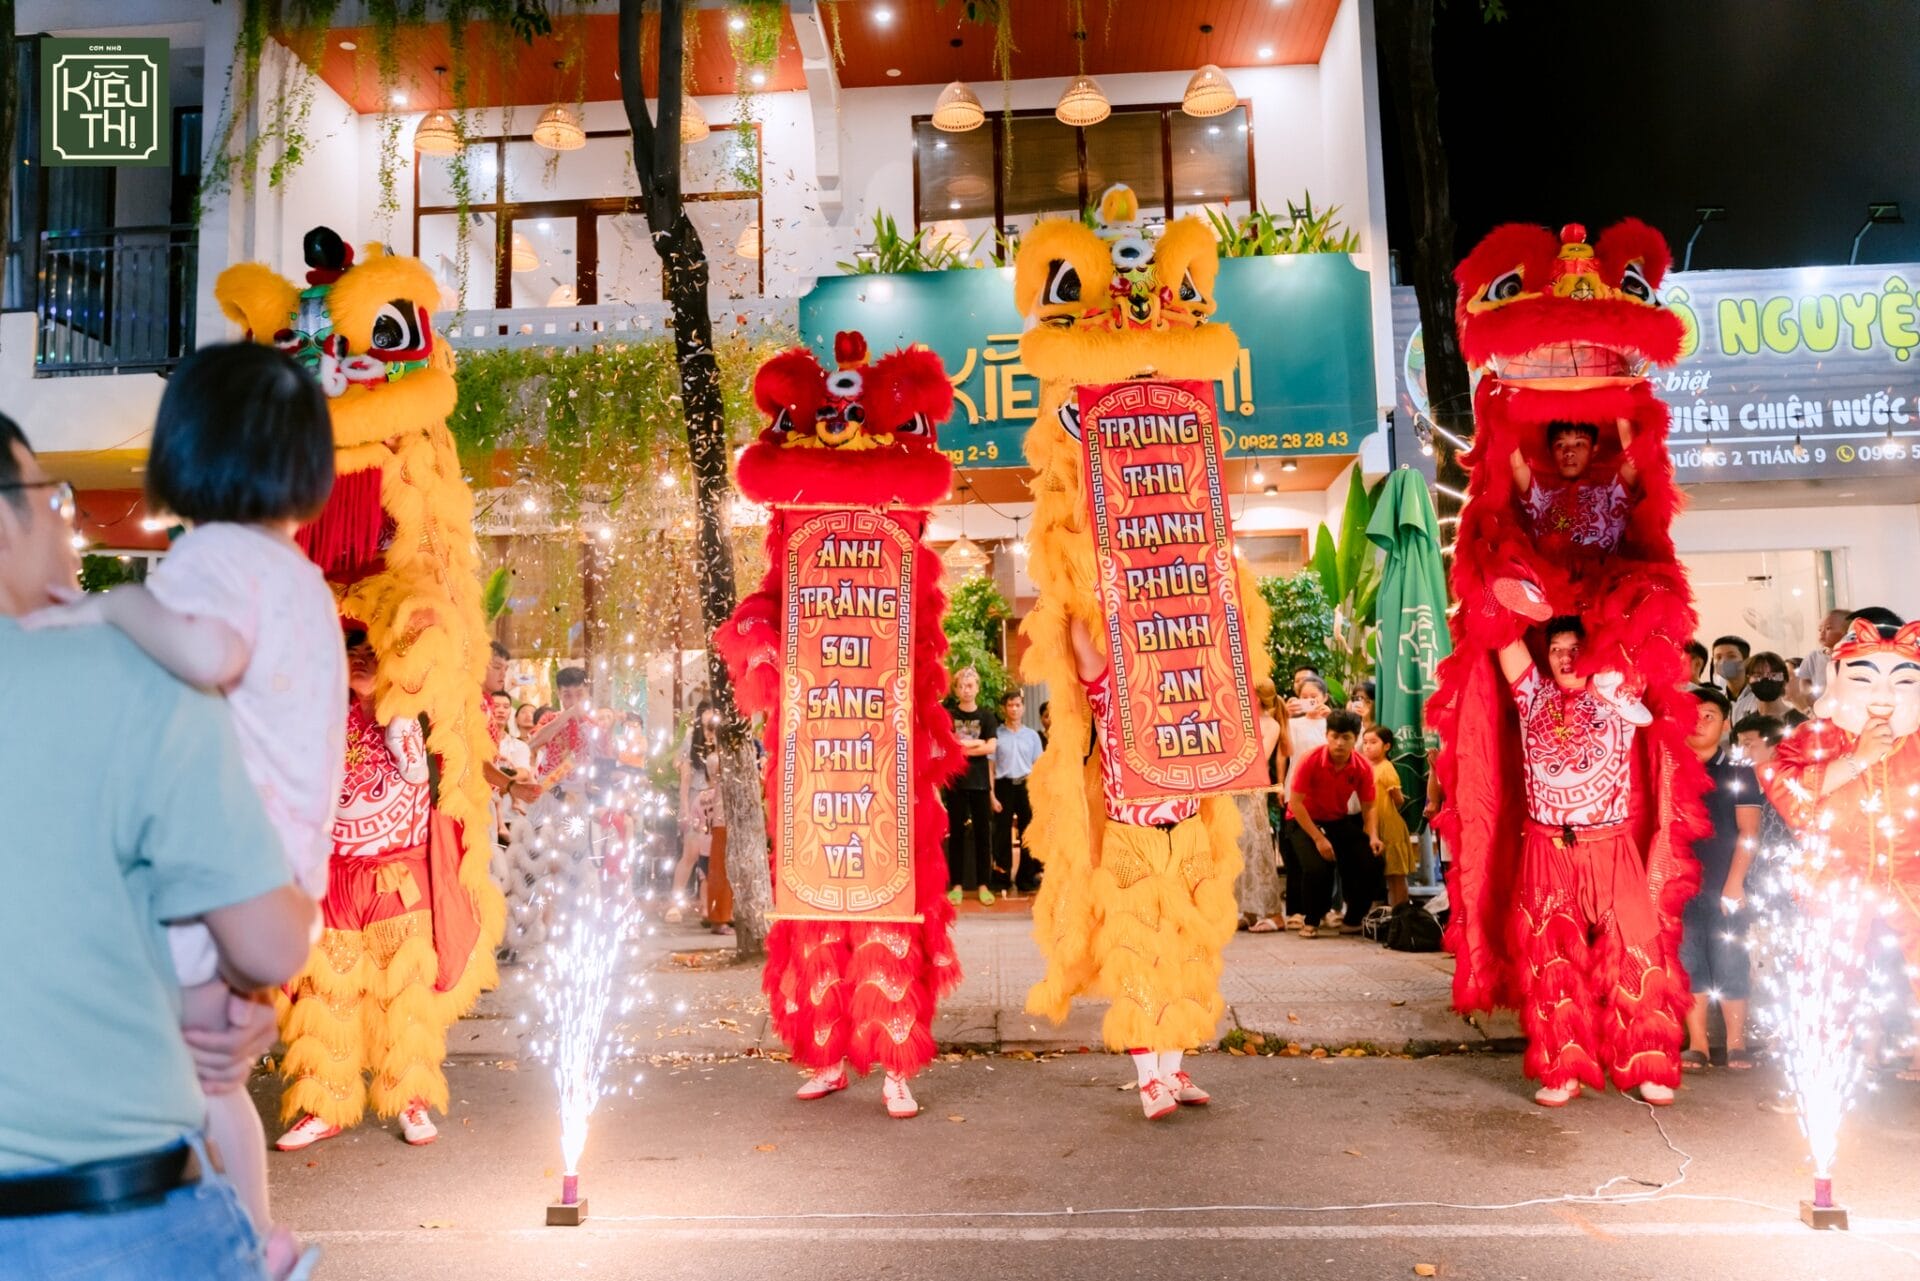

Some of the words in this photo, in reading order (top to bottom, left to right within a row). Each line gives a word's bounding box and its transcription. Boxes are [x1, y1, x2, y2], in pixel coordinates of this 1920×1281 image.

[1718, 276, 1920, 362] NGUYỆ
[1665, 370, 1712, 396] biệt
[1099, 412, 1201, 449] TRUNG
[1739, 394, 1823, 431] CHIÊN
[1832, 391, 1910, 428] NƯỚC
[1239, 434, 1278, 450] 0982
[1282, 433, 1302, 449] 28
[1304, 432, 1325, 448] 28
[1327, 431, 1349, 446] 43
[1669, 446, 1727, 468] ƯỜG
[1731, 450, 1743, 466] 2
[1747, 445, 1810, 466] THÁNG
[1815, 447, 1827, 463] 9
[1122, 463, 1189, 498] THU
[816, 534, 883, 568] ÁNH
[1115, 512, 1209, 554] HẠNH
[1124, 556, 1210, 600] PHÚC
[800, 579, 897, 620] TRĂNG
[821, 634, 872, 668] SOI
[1133, 611, 1215, 653] BÌNH
[806, 679, 884, 720] SÁNG
[1159, 667, 1207, 705] AN
[811, 731, 876, 772] PHÚ
[1154, 710, 1225, 759] ĐẾN
[811, 784, 876, 830] QUÝ
[822, 832, 864, 878] VỀ
